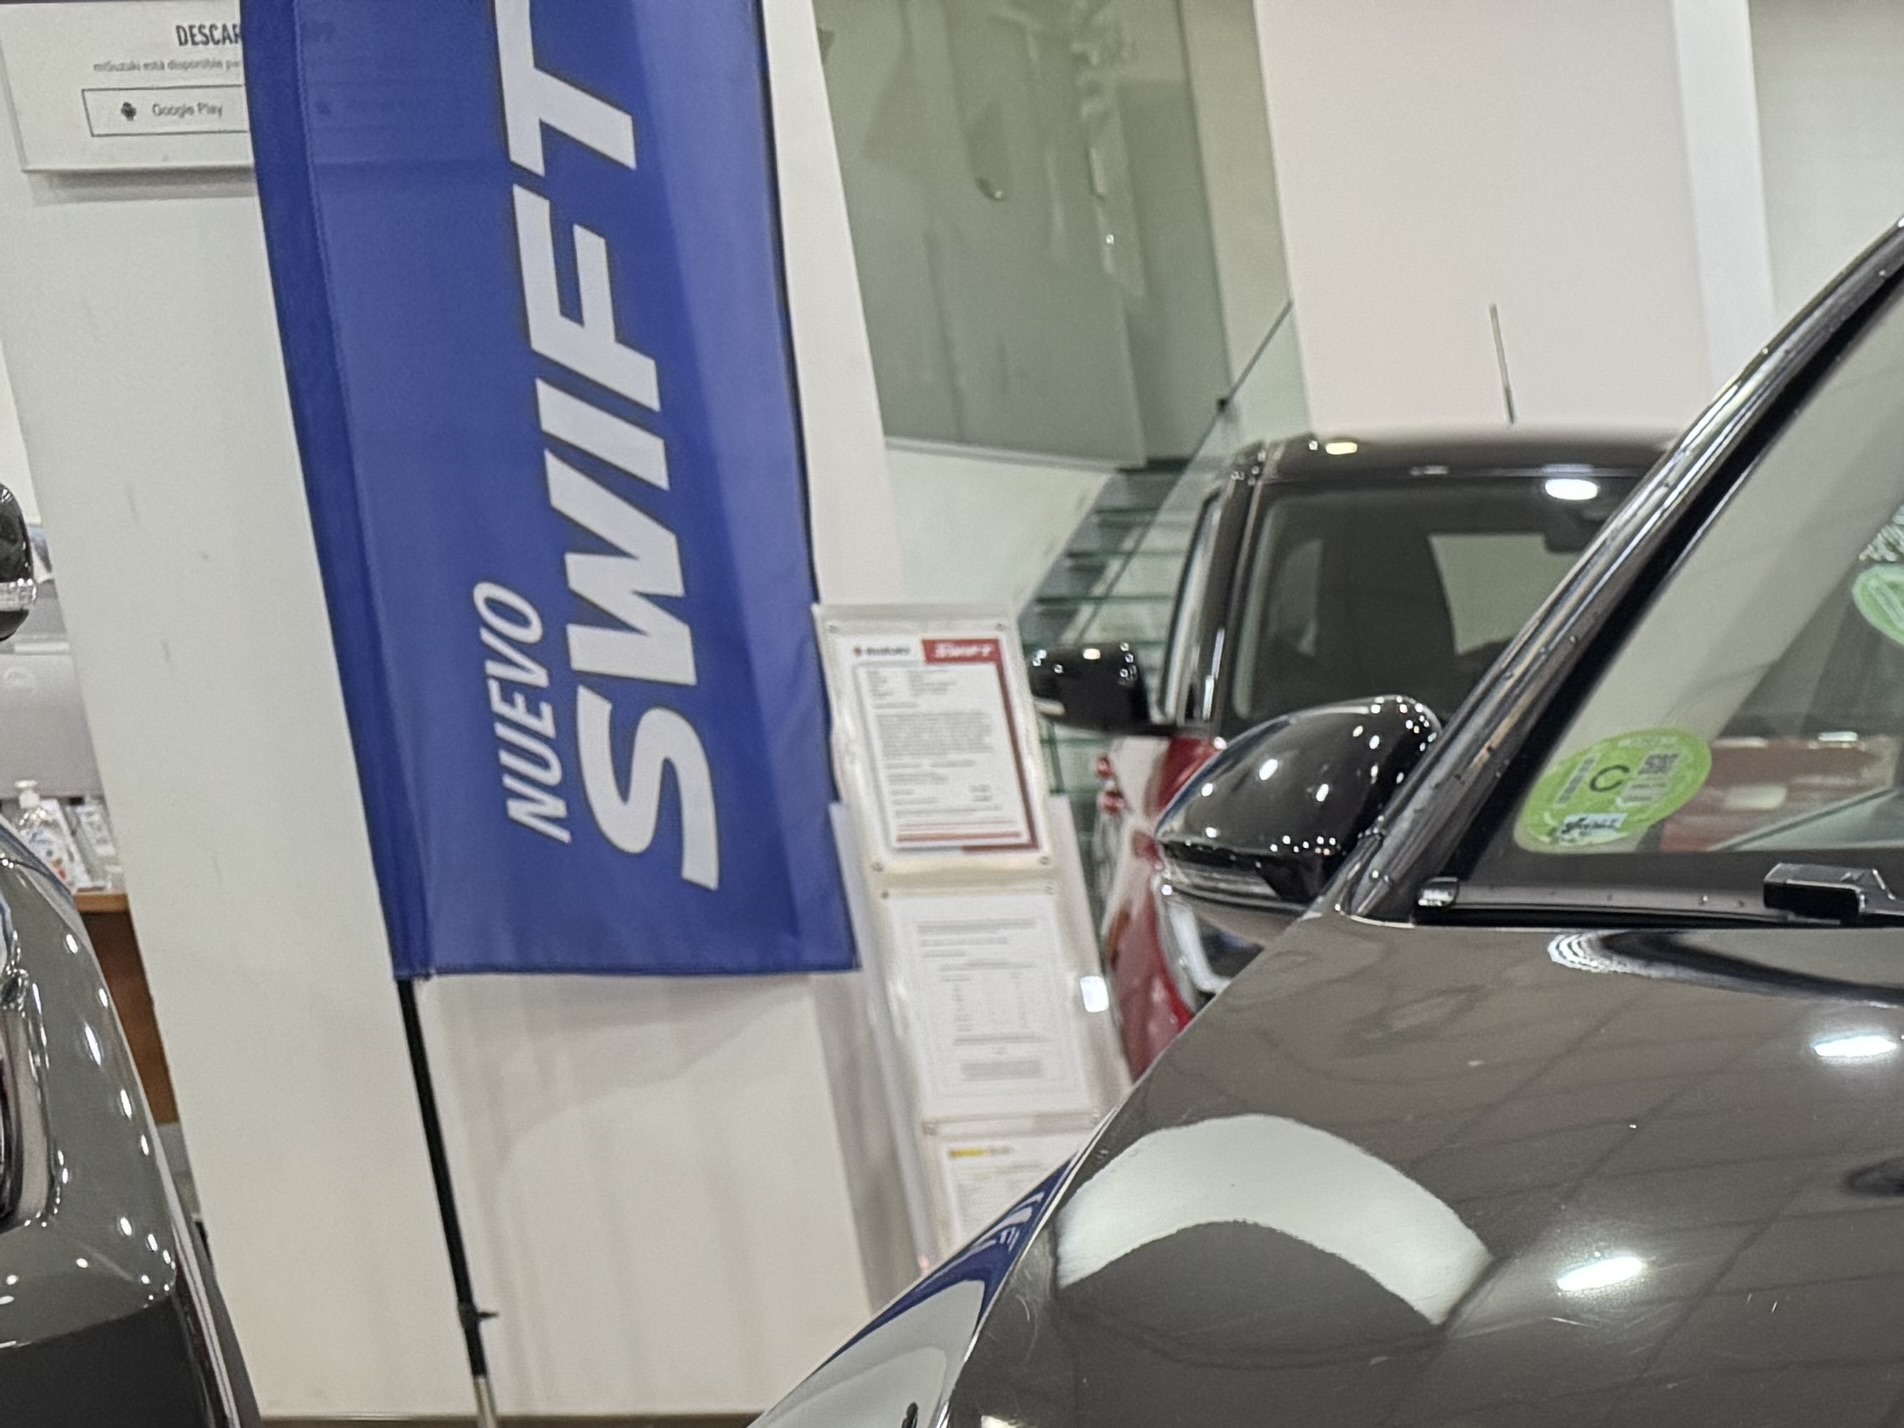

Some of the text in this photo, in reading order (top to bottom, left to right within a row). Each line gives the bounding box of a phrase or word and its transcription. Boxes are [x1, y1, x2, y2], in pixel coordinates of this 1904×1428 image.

[152, 102, 223, 119] Google Play
[495, 0, 717, 888] SWIFT
[474, 583, 569, 842] NUEVO
[1589, 764, 1630, 792] C
